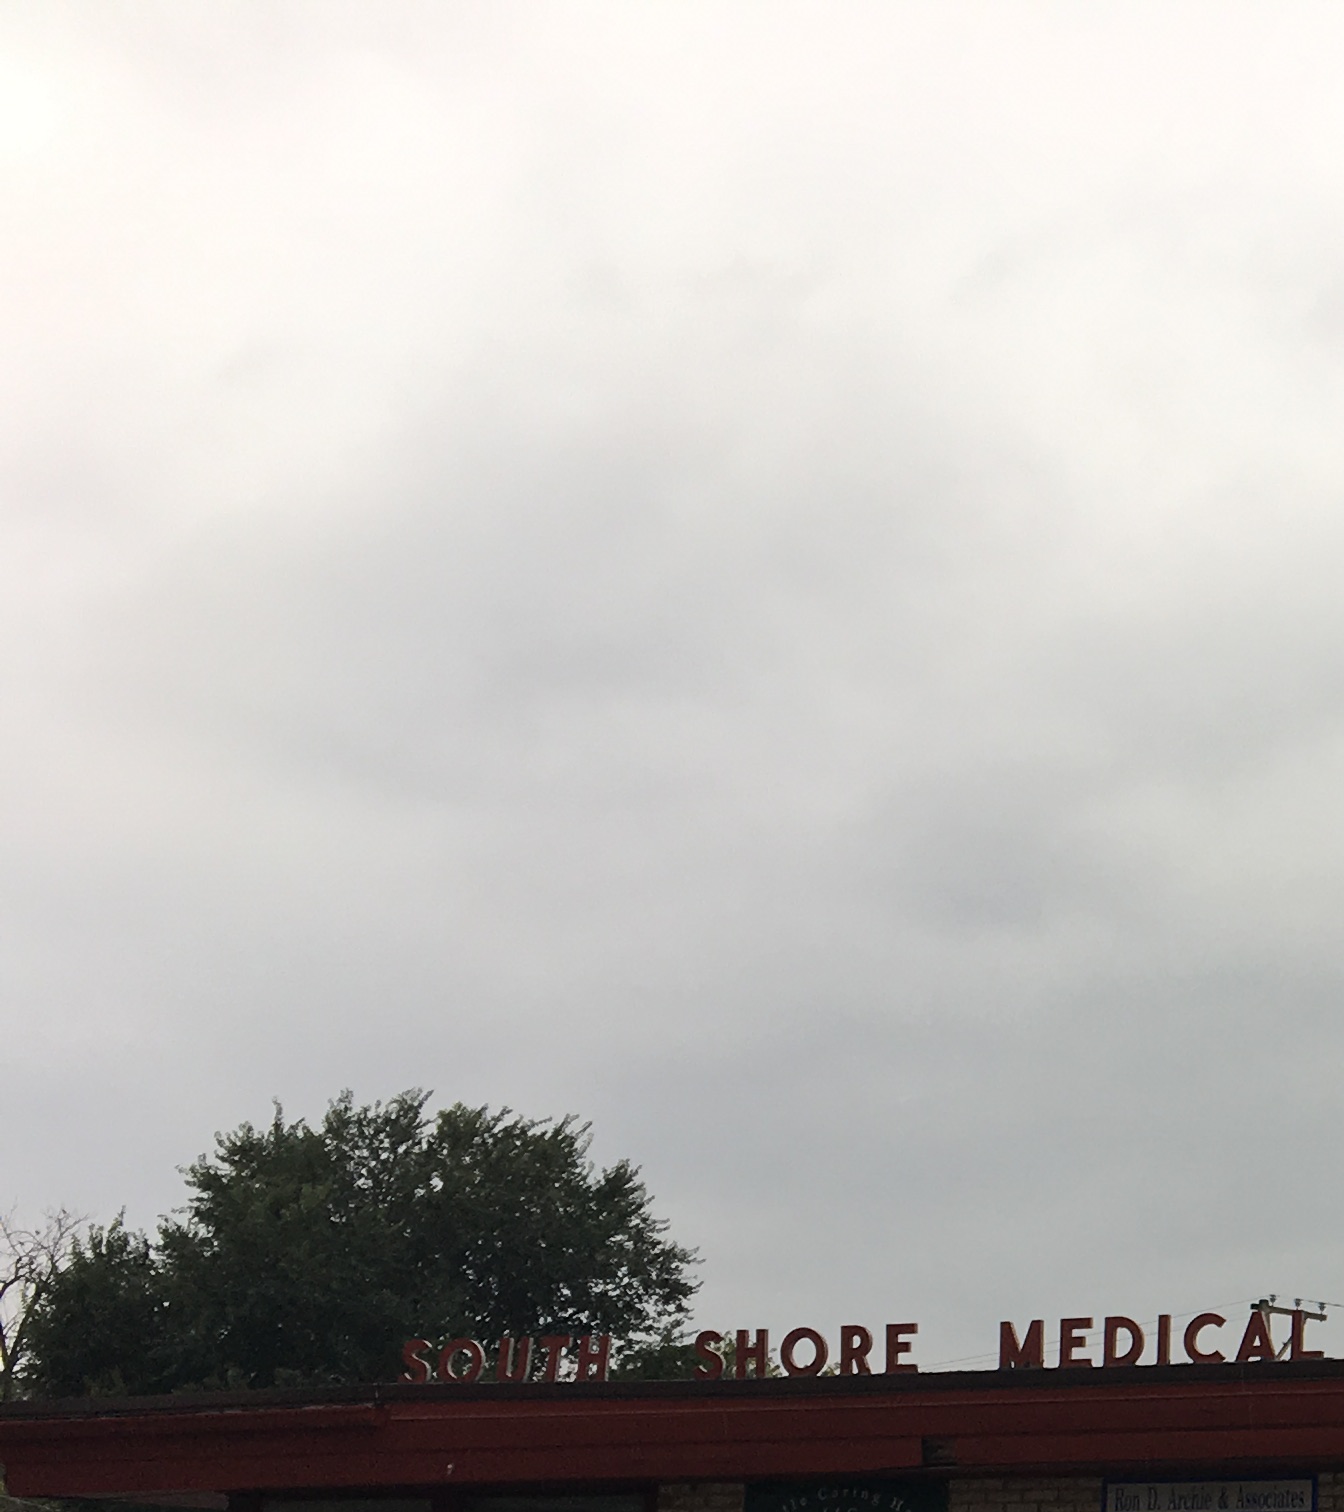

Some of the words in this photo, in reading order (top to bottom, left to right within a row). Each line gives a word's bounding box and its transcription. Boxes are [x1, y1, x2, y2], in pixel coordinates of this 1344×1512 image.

[398, 1334, 614, 1385] SOUTH
[694, 1323, 918, 1380] SHORE
[999, 1309, 1325, 1369] MEDICAL
[817, 1487, 882, 1505] Caring
[1114, 1487, 1140, 1512] Ron
[1147, 1486, 1160, 1510] D.
[1218, 1486, 1229, 1509] &
[1236, 1484, 1305, 1509] Associates
